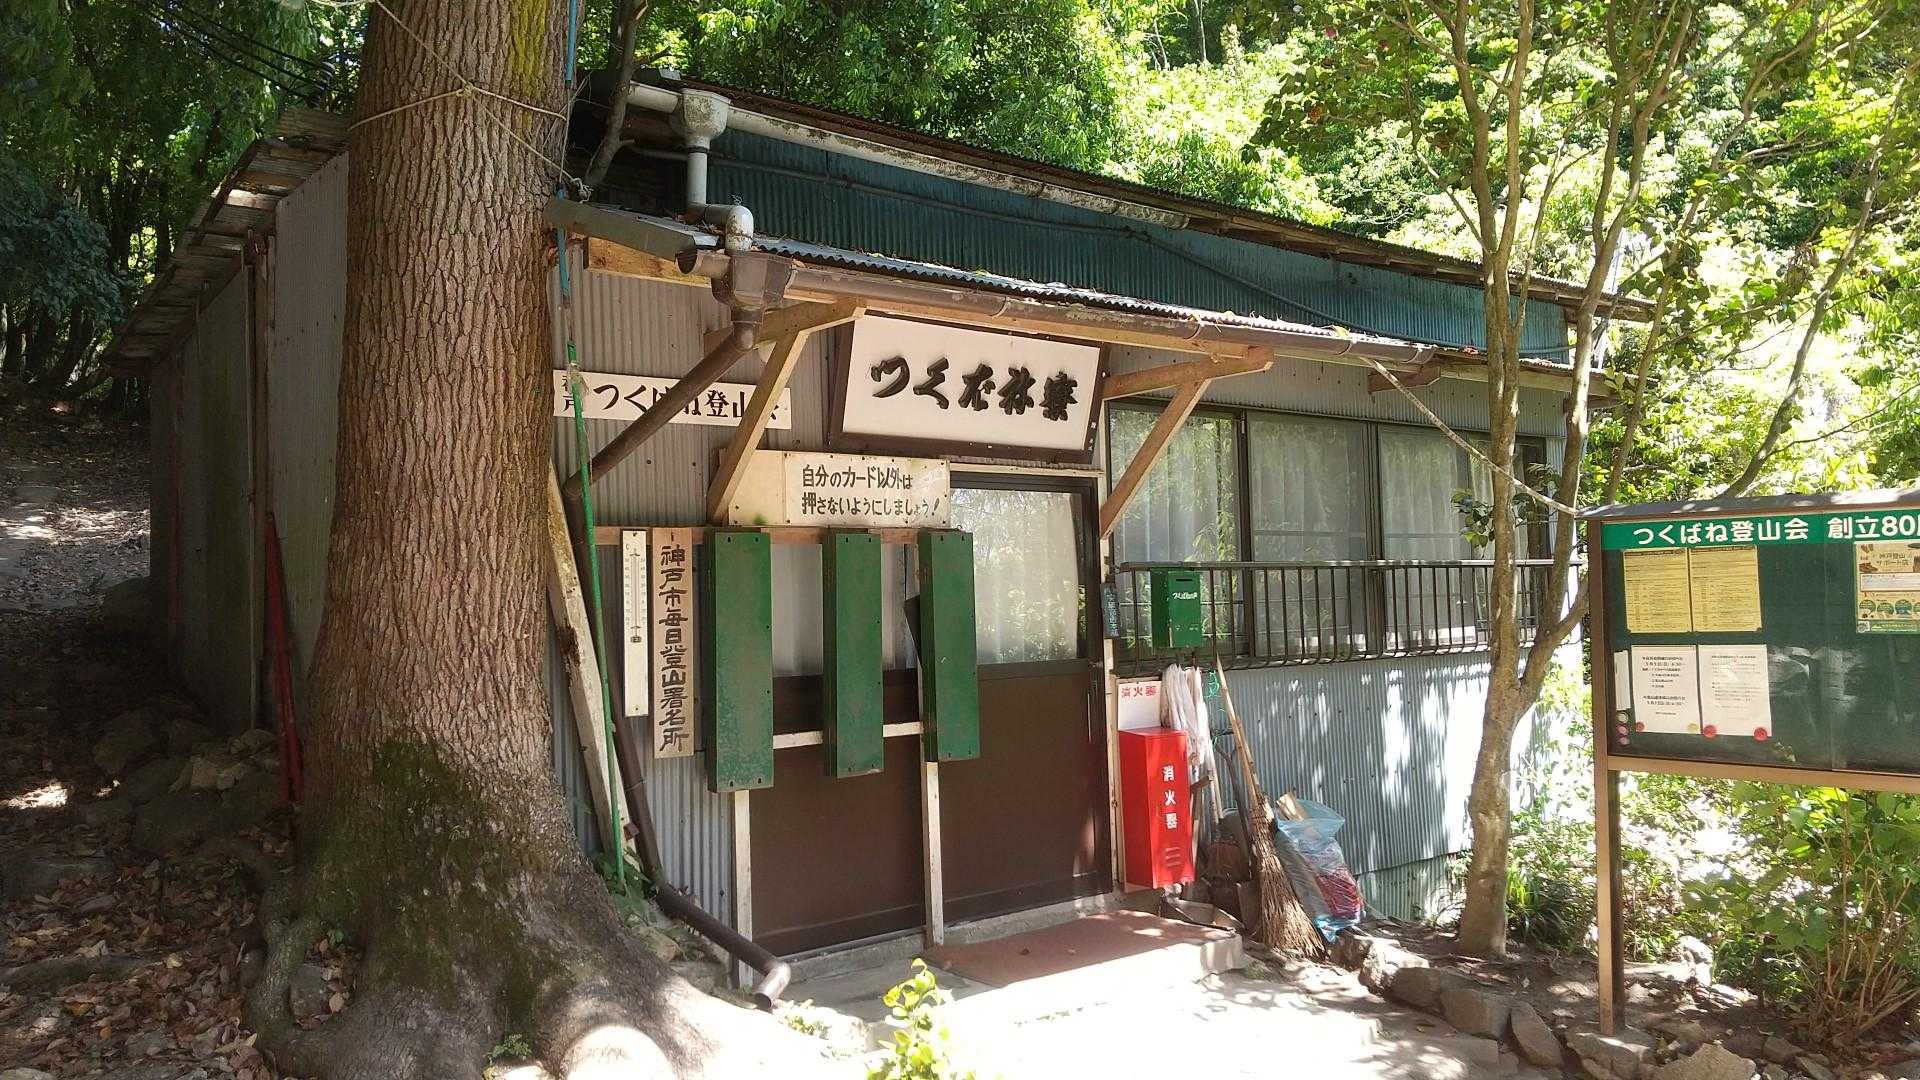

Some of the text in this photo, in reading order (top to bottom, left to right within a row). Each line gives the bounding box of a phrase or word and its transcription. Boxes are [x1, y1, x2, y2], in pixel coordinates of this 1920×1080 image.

[802, 464, 913, 489] 自分のカード以外は
[1633, 515, 1920, 545] つくばね登山会 創立80
